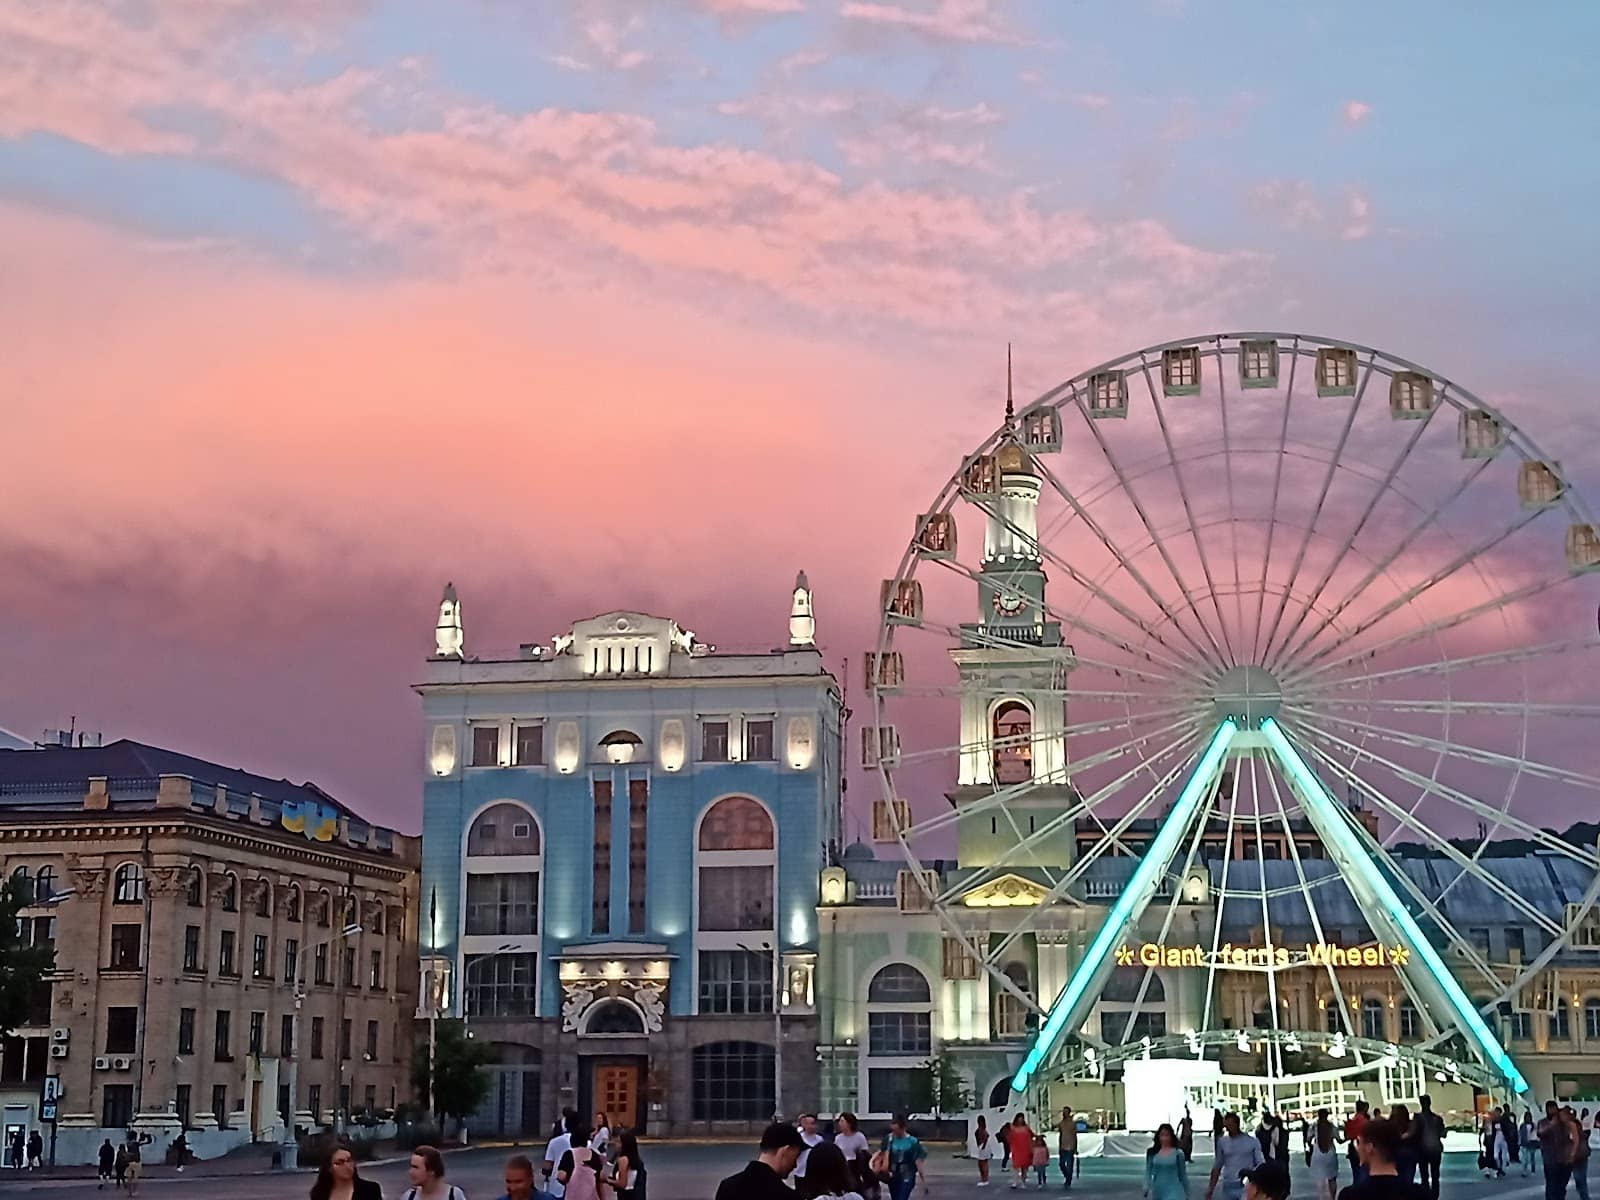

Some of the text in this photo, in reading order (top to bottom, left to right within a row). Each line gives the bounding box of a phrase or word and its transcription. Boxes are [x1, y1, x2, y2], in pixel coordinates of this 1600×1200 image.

[1140, 943, 1385, 967] Giant ferris Wheel
